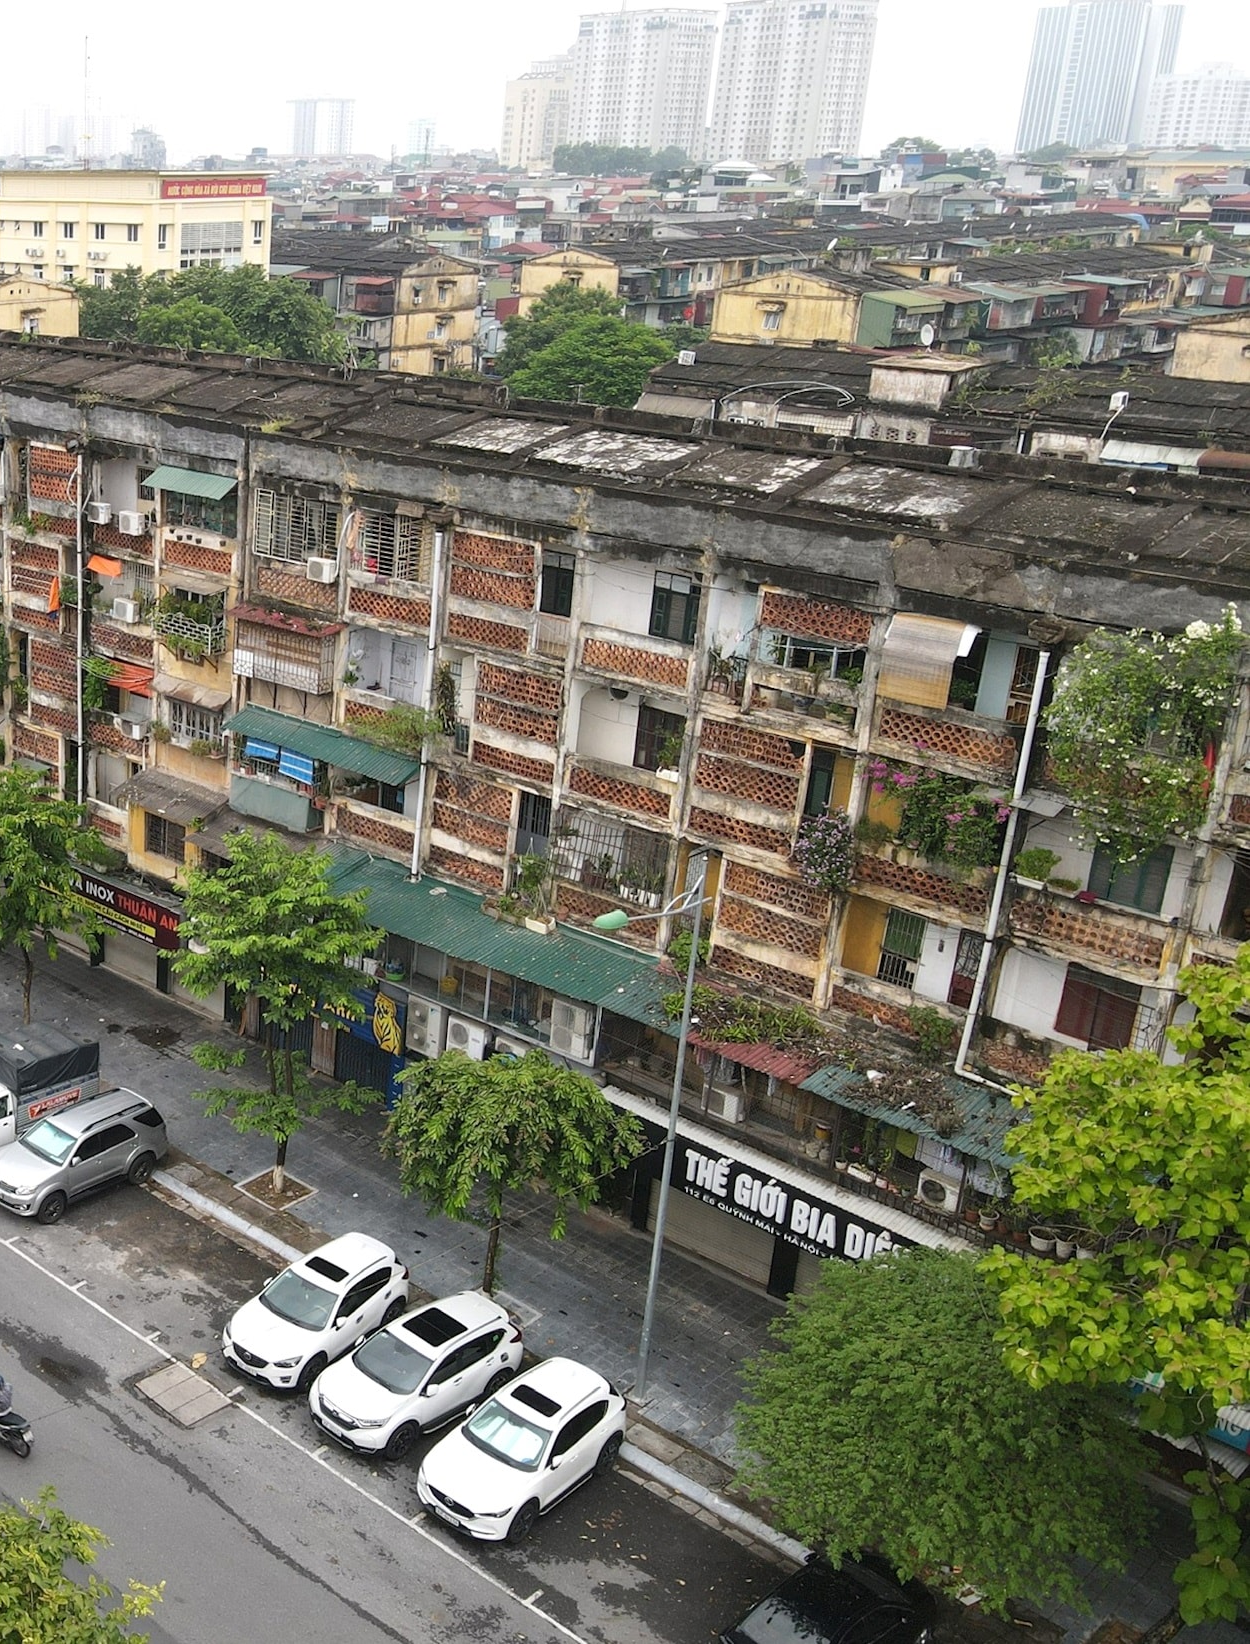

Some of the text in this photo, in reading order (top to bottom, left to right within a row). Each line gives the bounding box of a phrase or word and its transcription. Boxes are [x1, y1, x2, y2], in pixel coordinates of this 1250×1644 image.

[86, 880, 114, 904] INOX
[117, 894, 157, 923] THUẬN
[160, 914, 178, 931] AN
[684, 1186, 700, 1199] 112
[685, 1148, 735, 1197] THẾ
[734, 1172, 788, 1225] GIỚI
[790, 1199, 836, 1249] BIA
